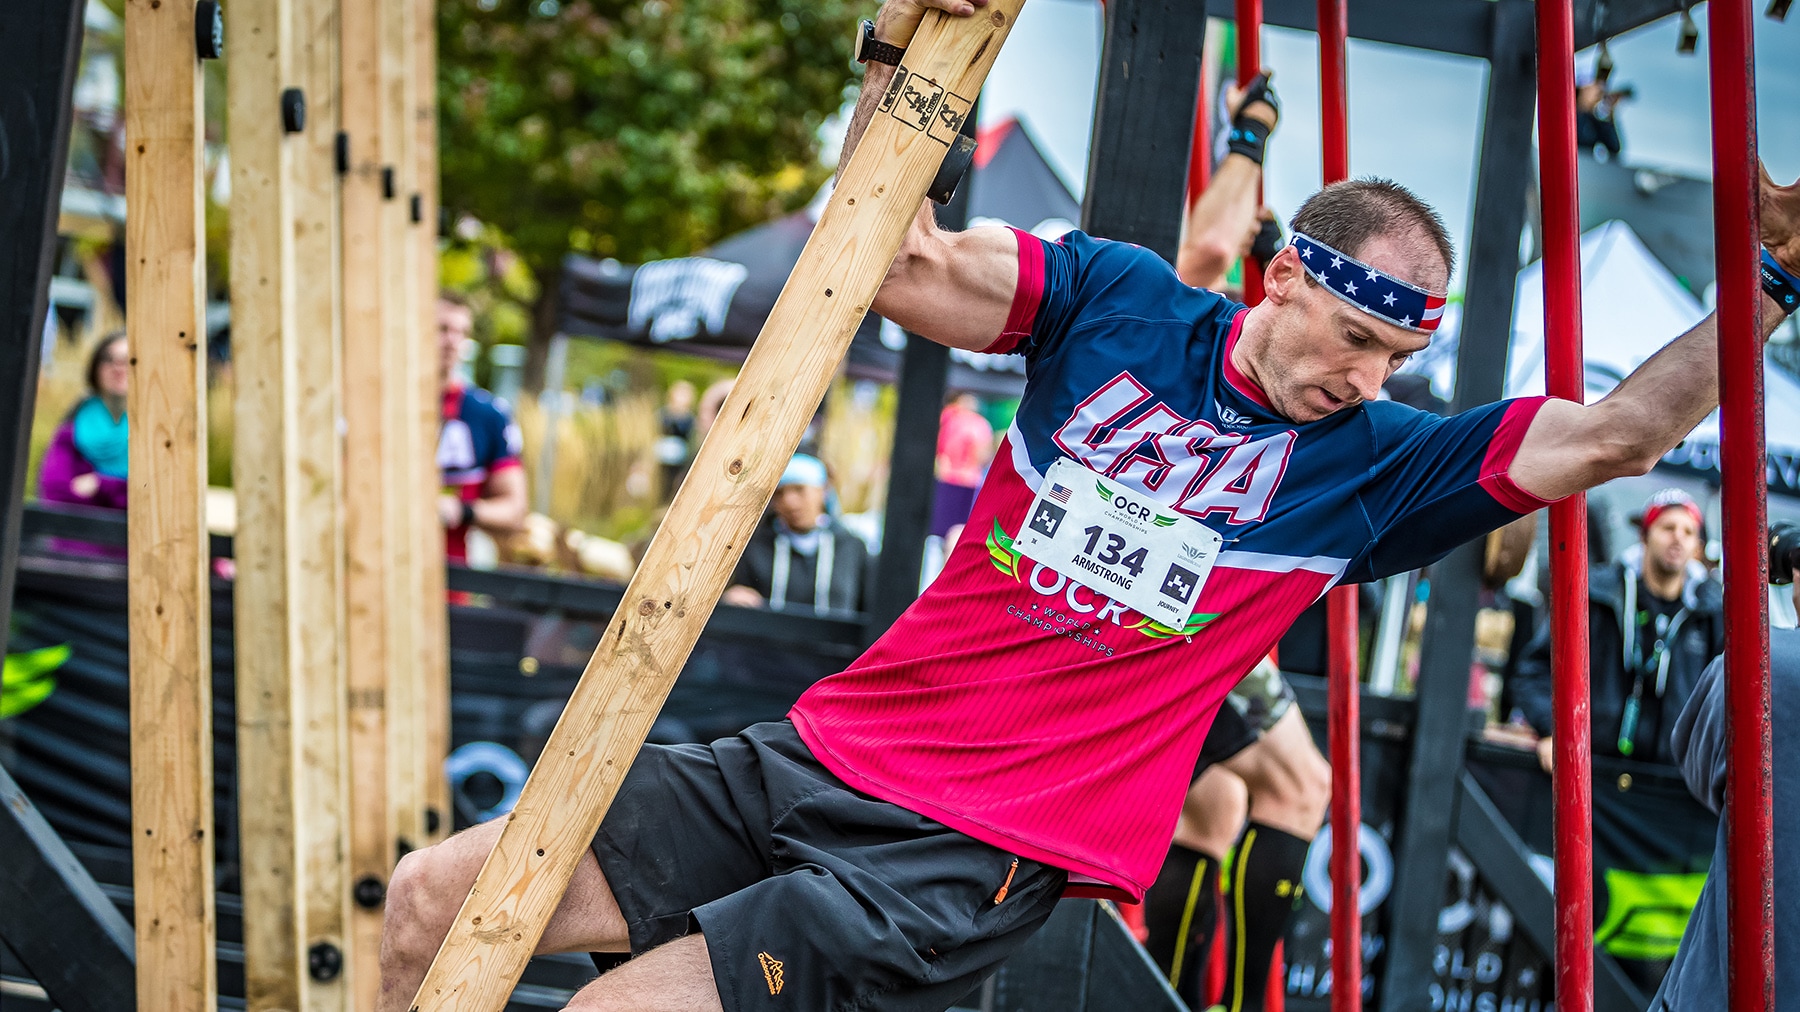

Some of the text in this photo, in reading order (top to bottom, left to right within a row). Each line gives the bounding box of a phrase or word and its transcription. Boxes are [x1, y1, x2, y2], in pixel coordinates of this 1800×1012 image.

[1051, 370, 1298, 525] USA
[1114, 496, 1151, 522] OCR
[1118, 511, 1139, 524] WORLD
[1104, 511, 1148, 534] CHAMPIONSHIPS
[1084, 524, 1149, 578] 134
[1071, 554, 1134, 591] ARMSTRONG
[1043, 606, 1091, 630] WORLD
[1157, 600, 1180, 614] JOURNEY
[1006, 604, 1115, 657] CHAMPONSHIPS
